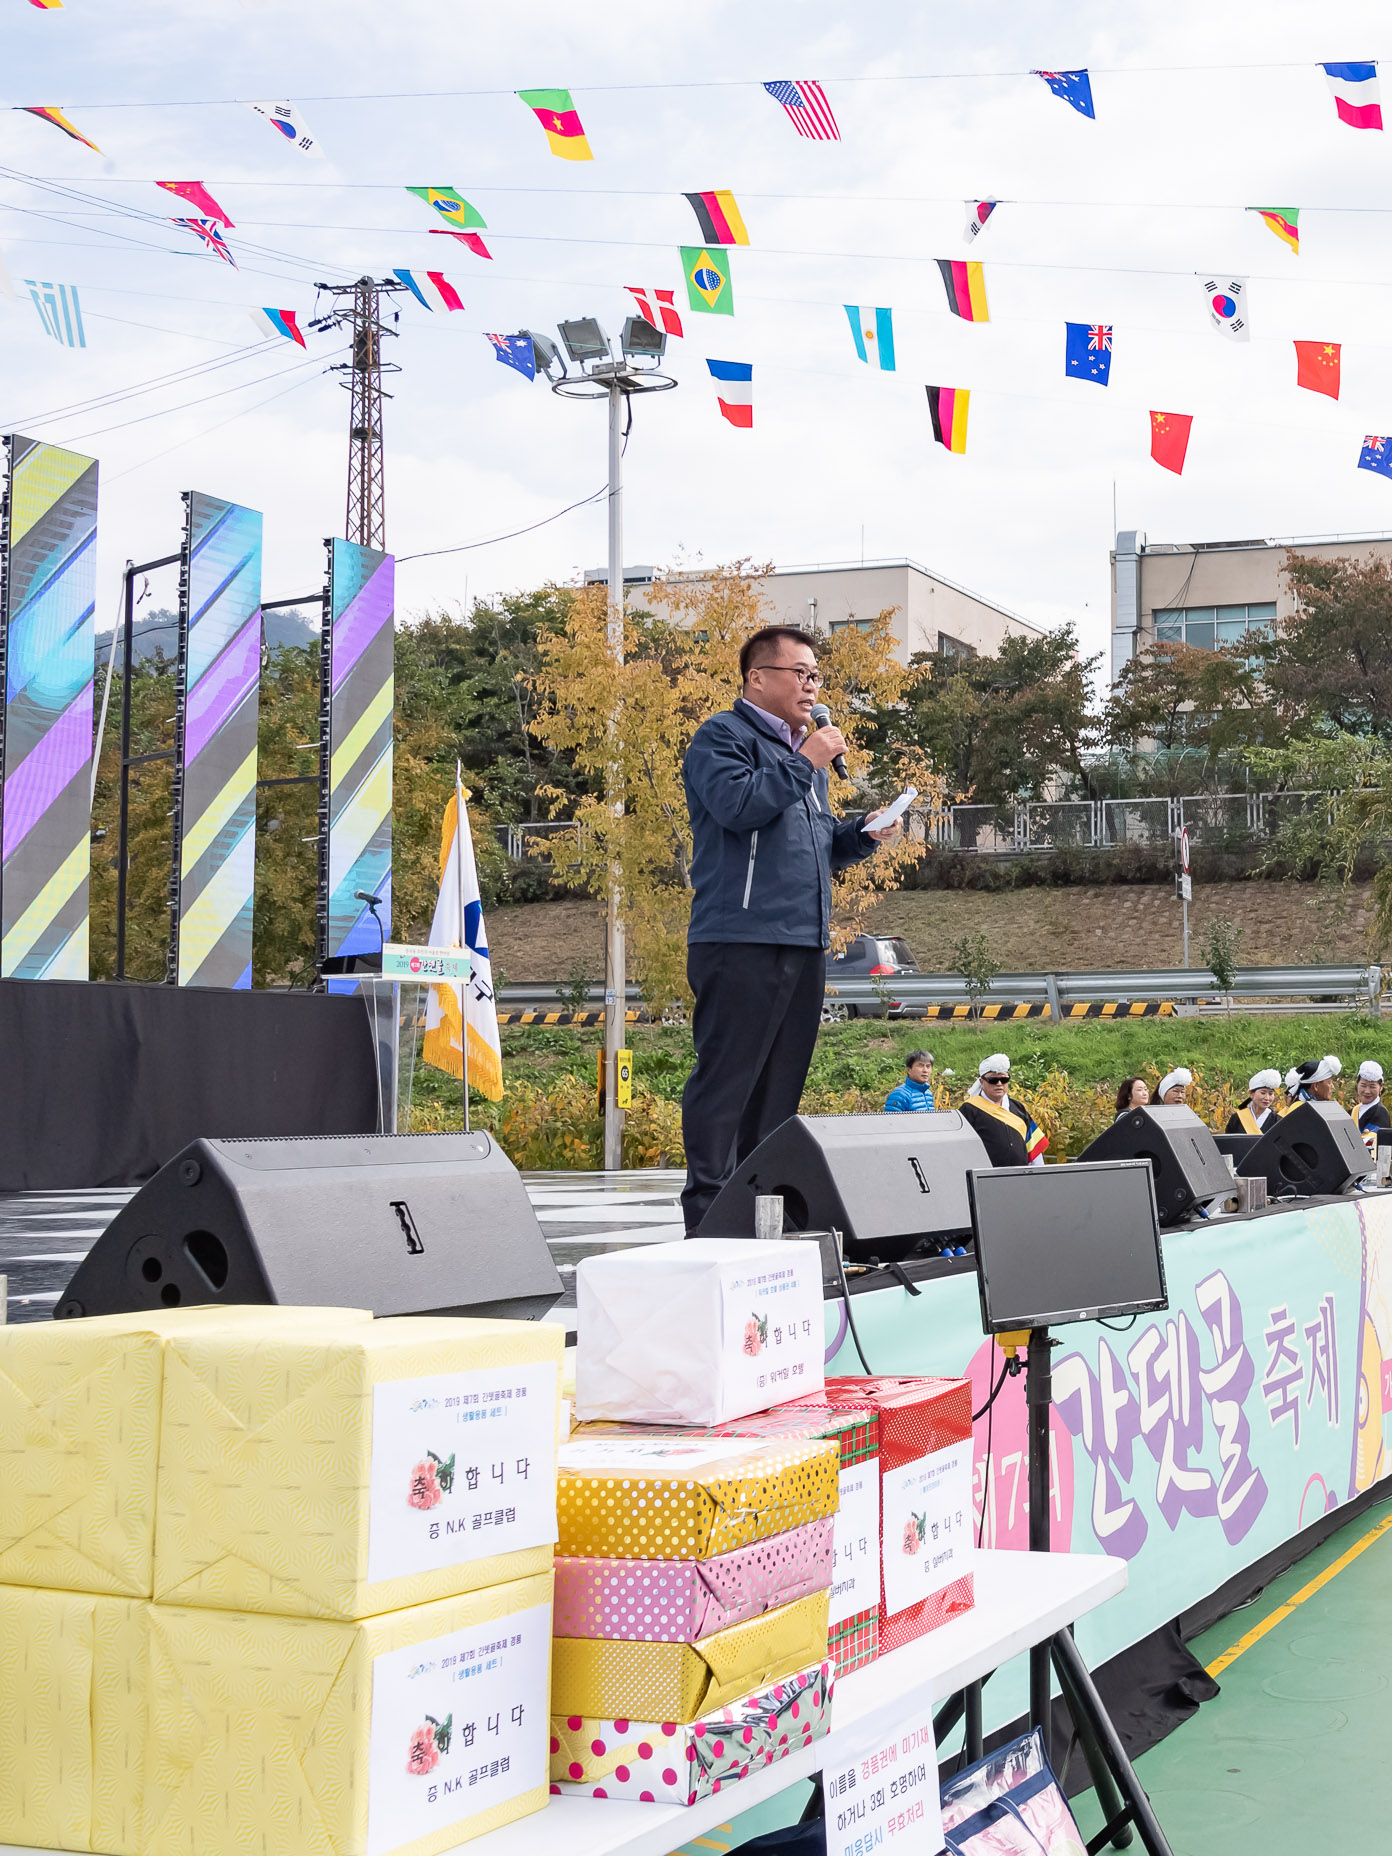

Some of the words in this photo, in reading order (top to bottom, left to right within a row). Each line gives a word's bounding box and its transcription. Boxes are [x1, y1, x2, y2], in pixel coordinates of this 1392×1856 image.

[445, 1396, 461, 1408] 2019
[463, 1394, 479, 1405] 제7회
[515, 1387, 527, 1398] 경품
[1050, 1269, 1266, 1552] 간뎃골
[1263, 1292, 1341, 1450] 축제
[429, 1522, 440, 1540] 증
[446, 1518, 466, 1535] N.K
[472, 1507, 516, 1531] 골프클럽
[441, 1656, 457, 1669] 2019
[510, 1634, 522, 1647] 경품
[427, 1785, 438, 1803] 증
[444, 1776, 463, 1795] N.K
[468, 1755, 510, 1786] 골프클럽
[829, 1768, 857, 1799] 이름을
[861, 1743, 898, 1780] 경품권에
[902, 1725, 930, 1755] 미기재
[837, 1799, 866, 1831] 하거나
[870, 1787, 885, 1812] 3회
[890, 1763, 927, 1799] 호명하여
[887, 1800, 924, 1837] 무효처리
